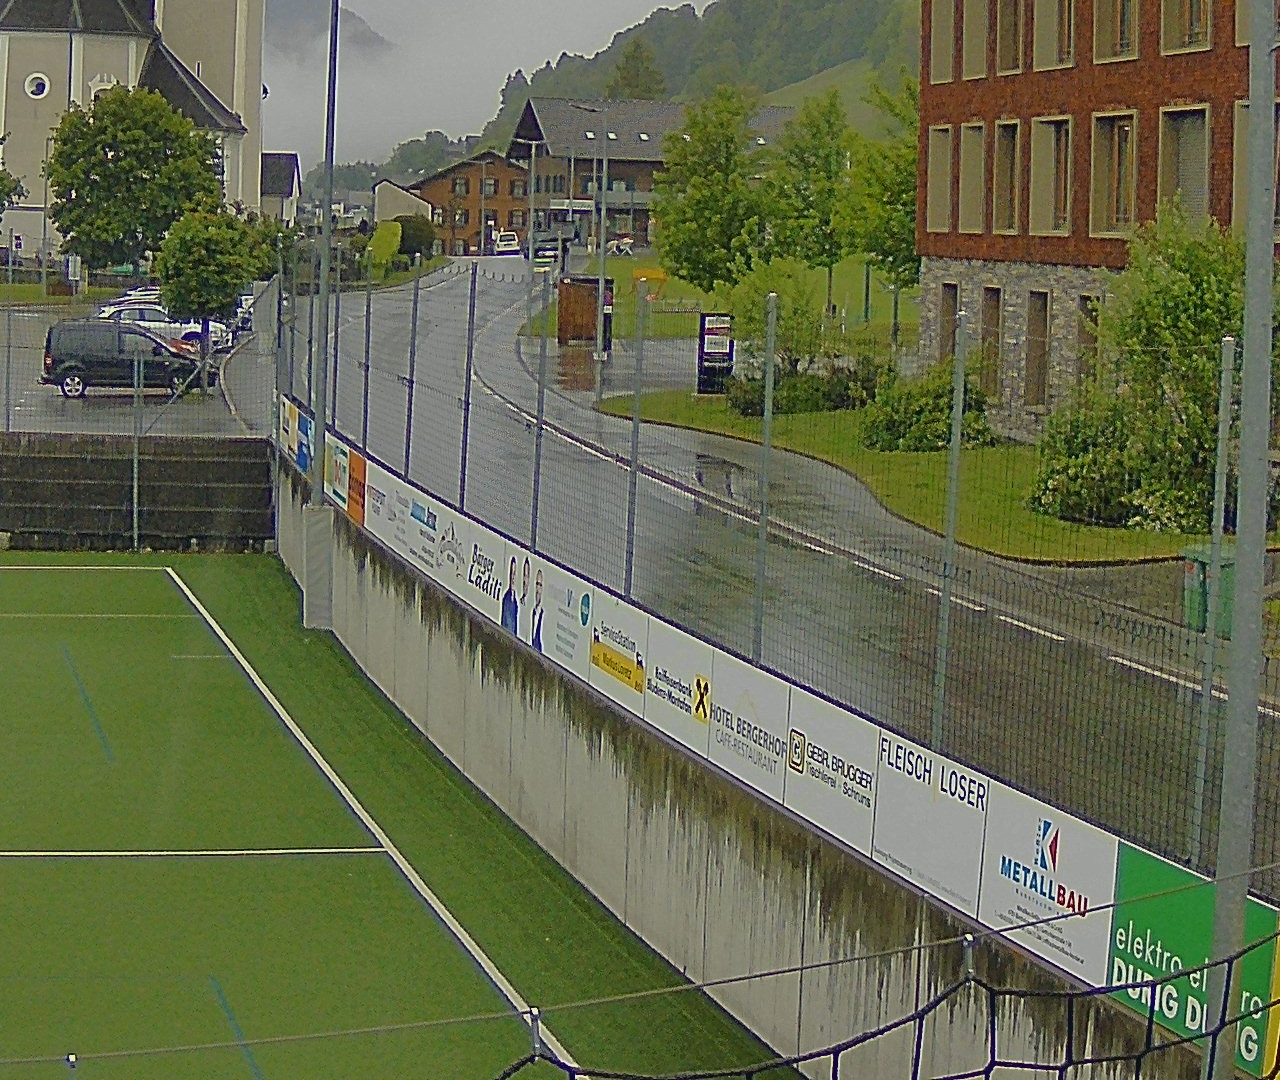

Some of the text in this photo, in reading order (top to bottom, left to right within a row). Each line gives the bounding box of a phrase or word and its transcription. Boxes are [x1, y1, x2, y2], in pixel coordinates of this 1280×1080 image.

[710, 703, 735, 731] HOTEL
[806, 742, 873, 792] GEBR. BRUGGER
[880, 737, 986, 812] FLEISCH LOSER
[1000, 855, 1088, 918] METALLBAU
[1116, 920, 1183, 974] elektro
